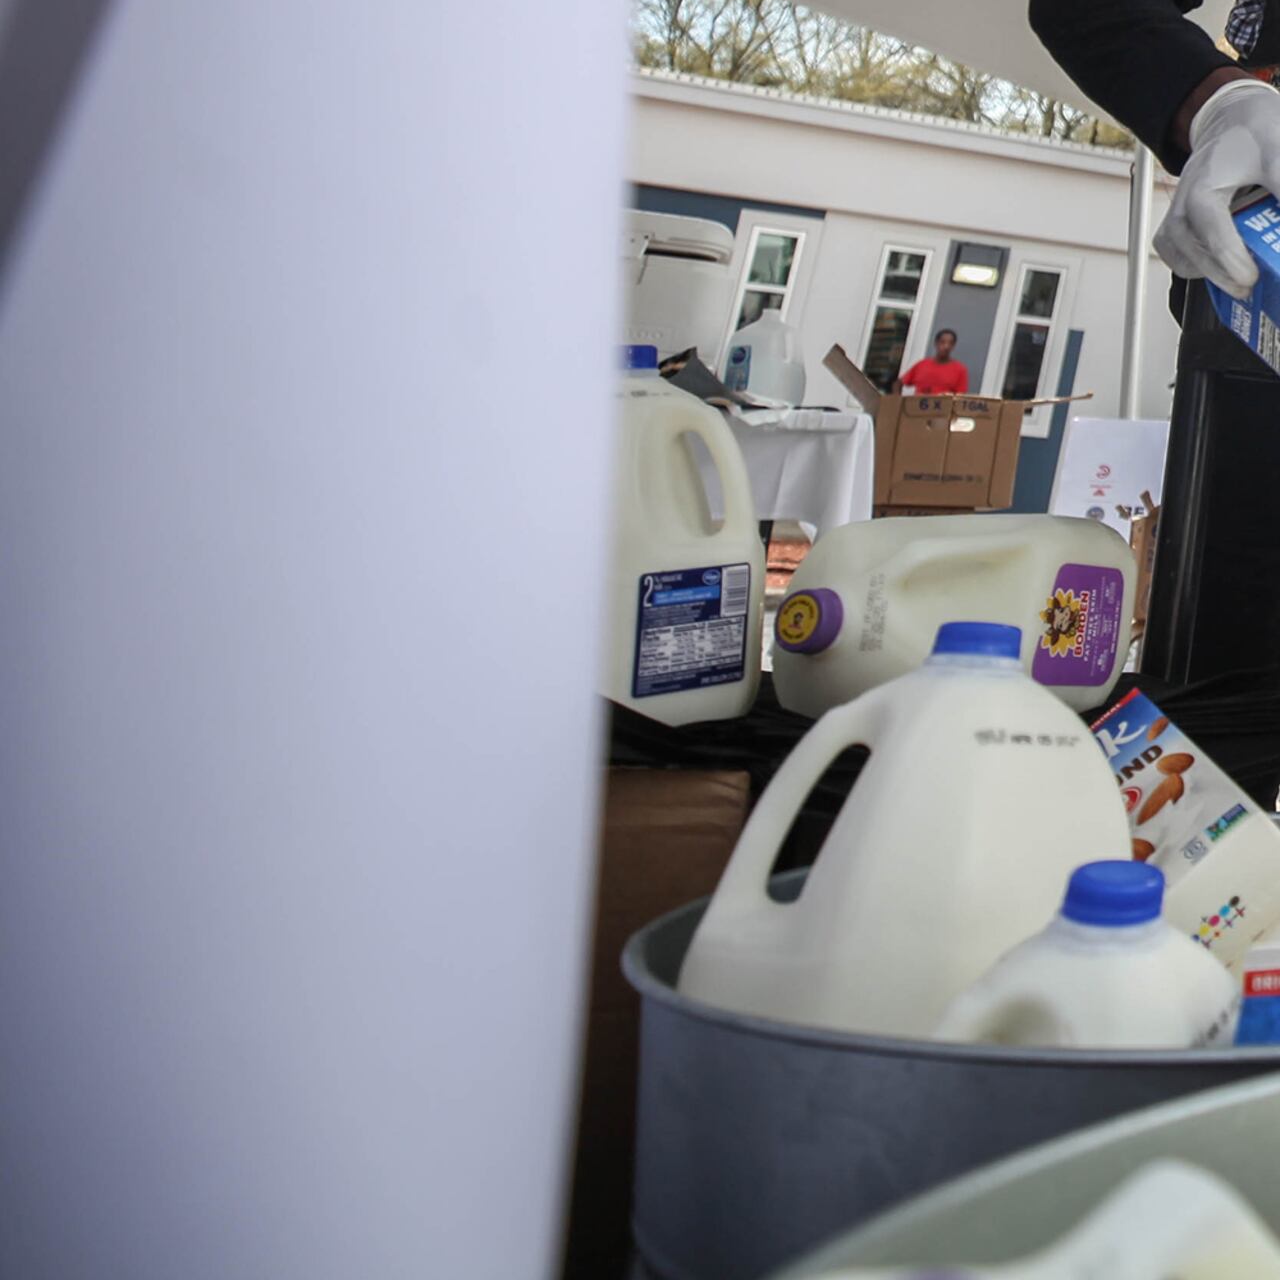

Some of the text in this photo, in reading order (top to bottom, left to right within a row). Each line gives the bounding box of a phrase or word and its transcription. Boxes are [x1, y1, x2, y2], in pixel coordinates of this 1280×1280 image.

[919, 399, 929, 410] 6
[643, 575, 654, 608] 2
[1073, 590, 1091, 658] BORDEN
